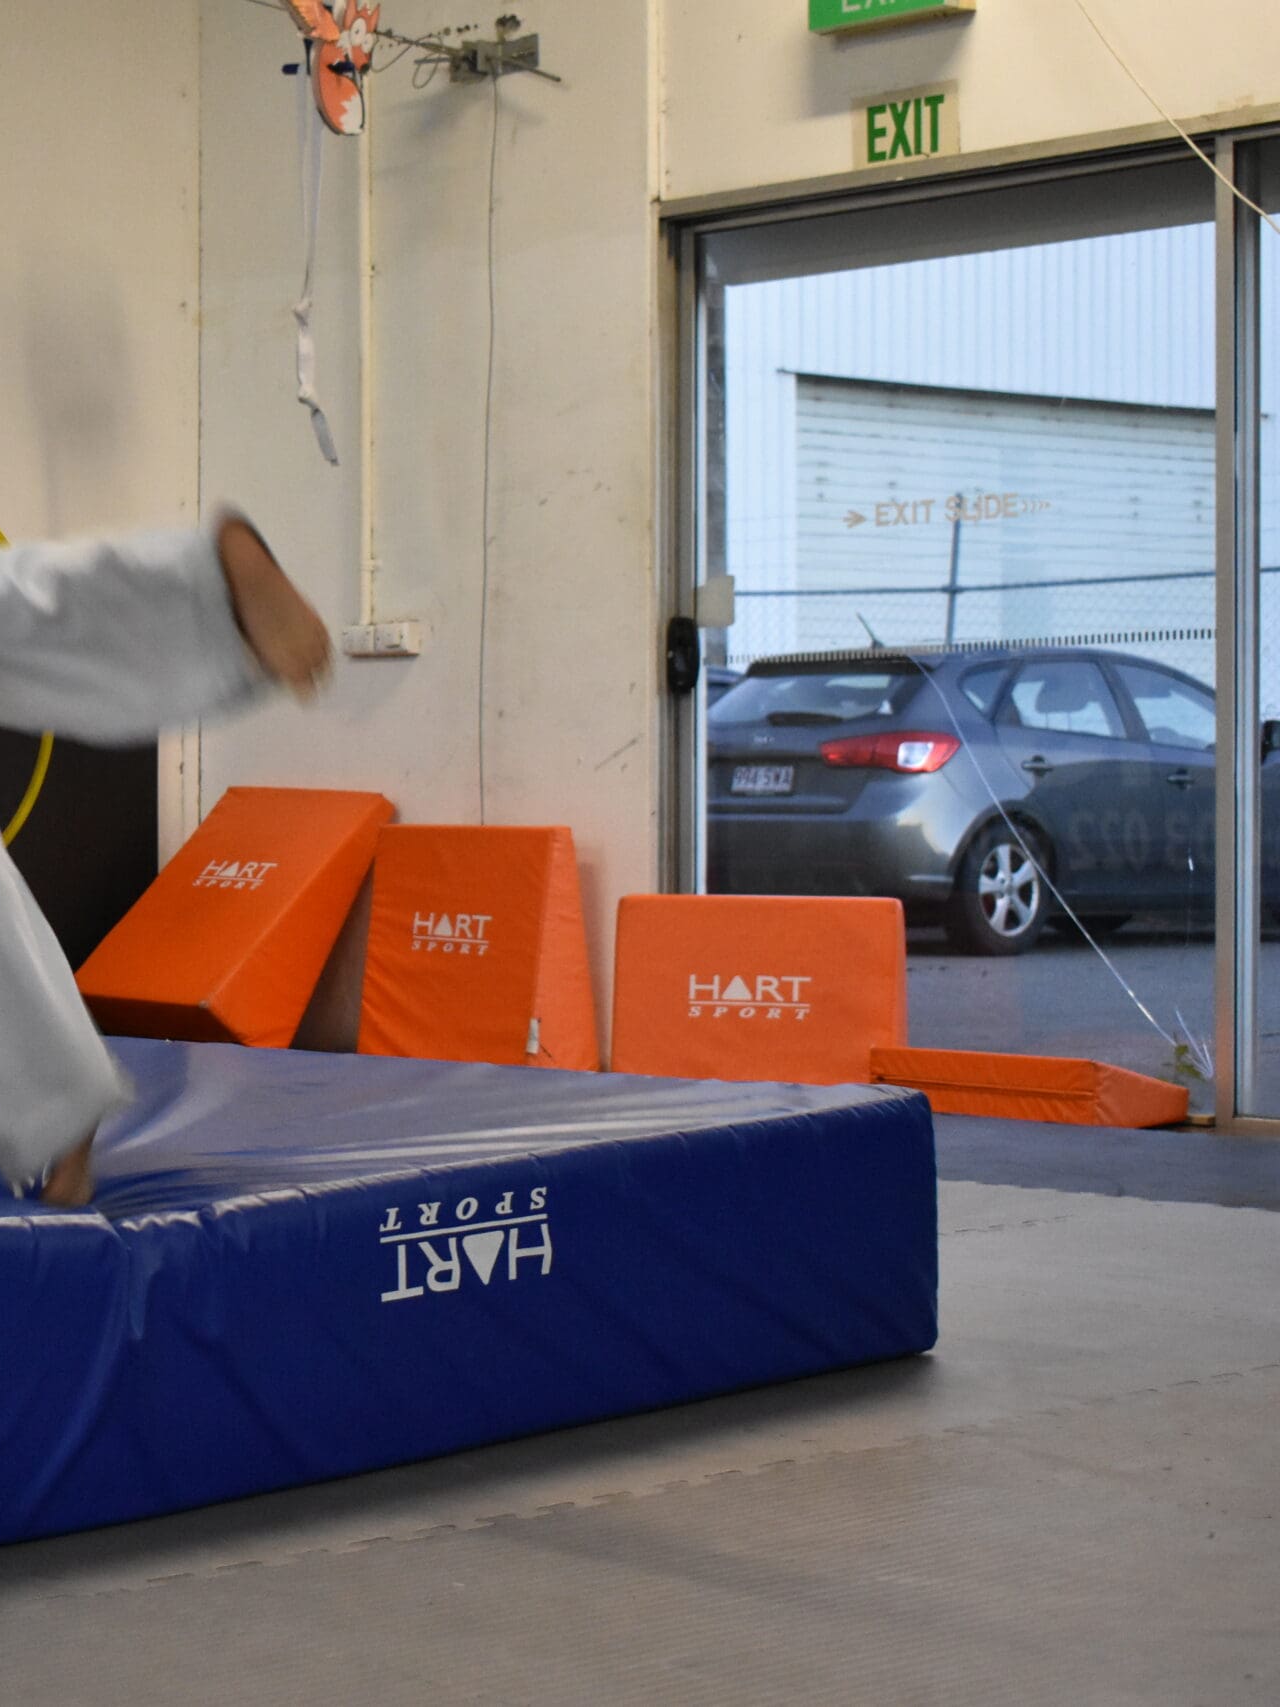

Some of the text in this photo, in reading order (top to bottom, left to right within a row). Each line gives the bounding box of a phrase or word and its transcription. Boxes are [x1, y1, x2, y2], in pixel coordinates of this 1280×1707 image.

[866, 94, 945, 163] EXIT
[874, 492, 1019, 527] EXIT SLIDE
[200, 859, 279, 880] HART
[192, 878, 264, 891] SPORT
[412, 911, 493, 940] HART
[411, 940, 489, 956] SPORT
[688, 973, 812, 1002] HART
[688, 1005, 810, 1020] SPORT
[379, 1186, 548, 1232] SPORT
[380, 1223, 552, 1302] HART
